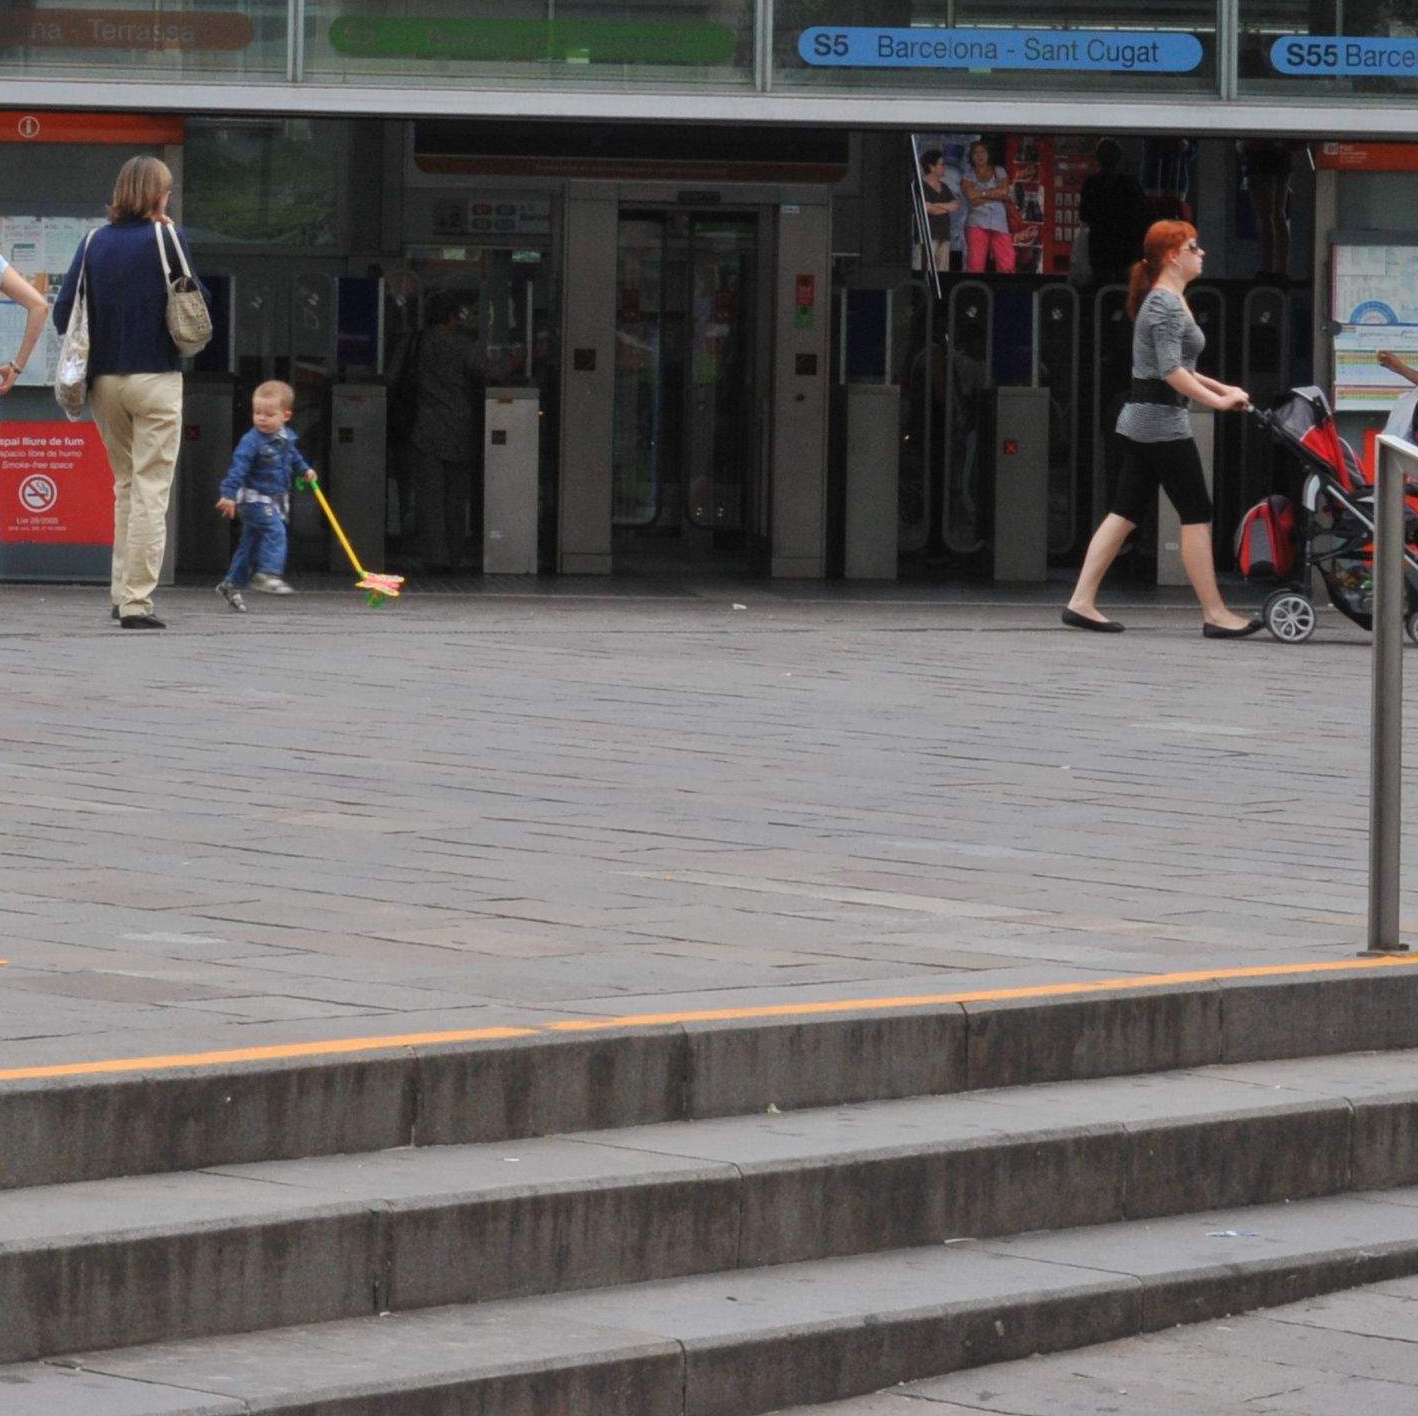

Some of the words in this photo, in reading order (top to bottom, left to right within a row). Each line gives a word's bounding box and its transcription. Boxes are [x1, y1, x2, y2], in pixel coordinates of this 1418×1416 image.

[88, 18, 196, 45] Terrassa
[813, 34, 849, 57] S5
[878, 36, 998, 60] Barcelona
[1024, 38, 1079, 62] Sant
[1087, 38, 1159, 69] Cugat
[1285, 43, 1339, 67] S55
[49, 437, 62, 446] de
[64, 437, 85, 446] fum
